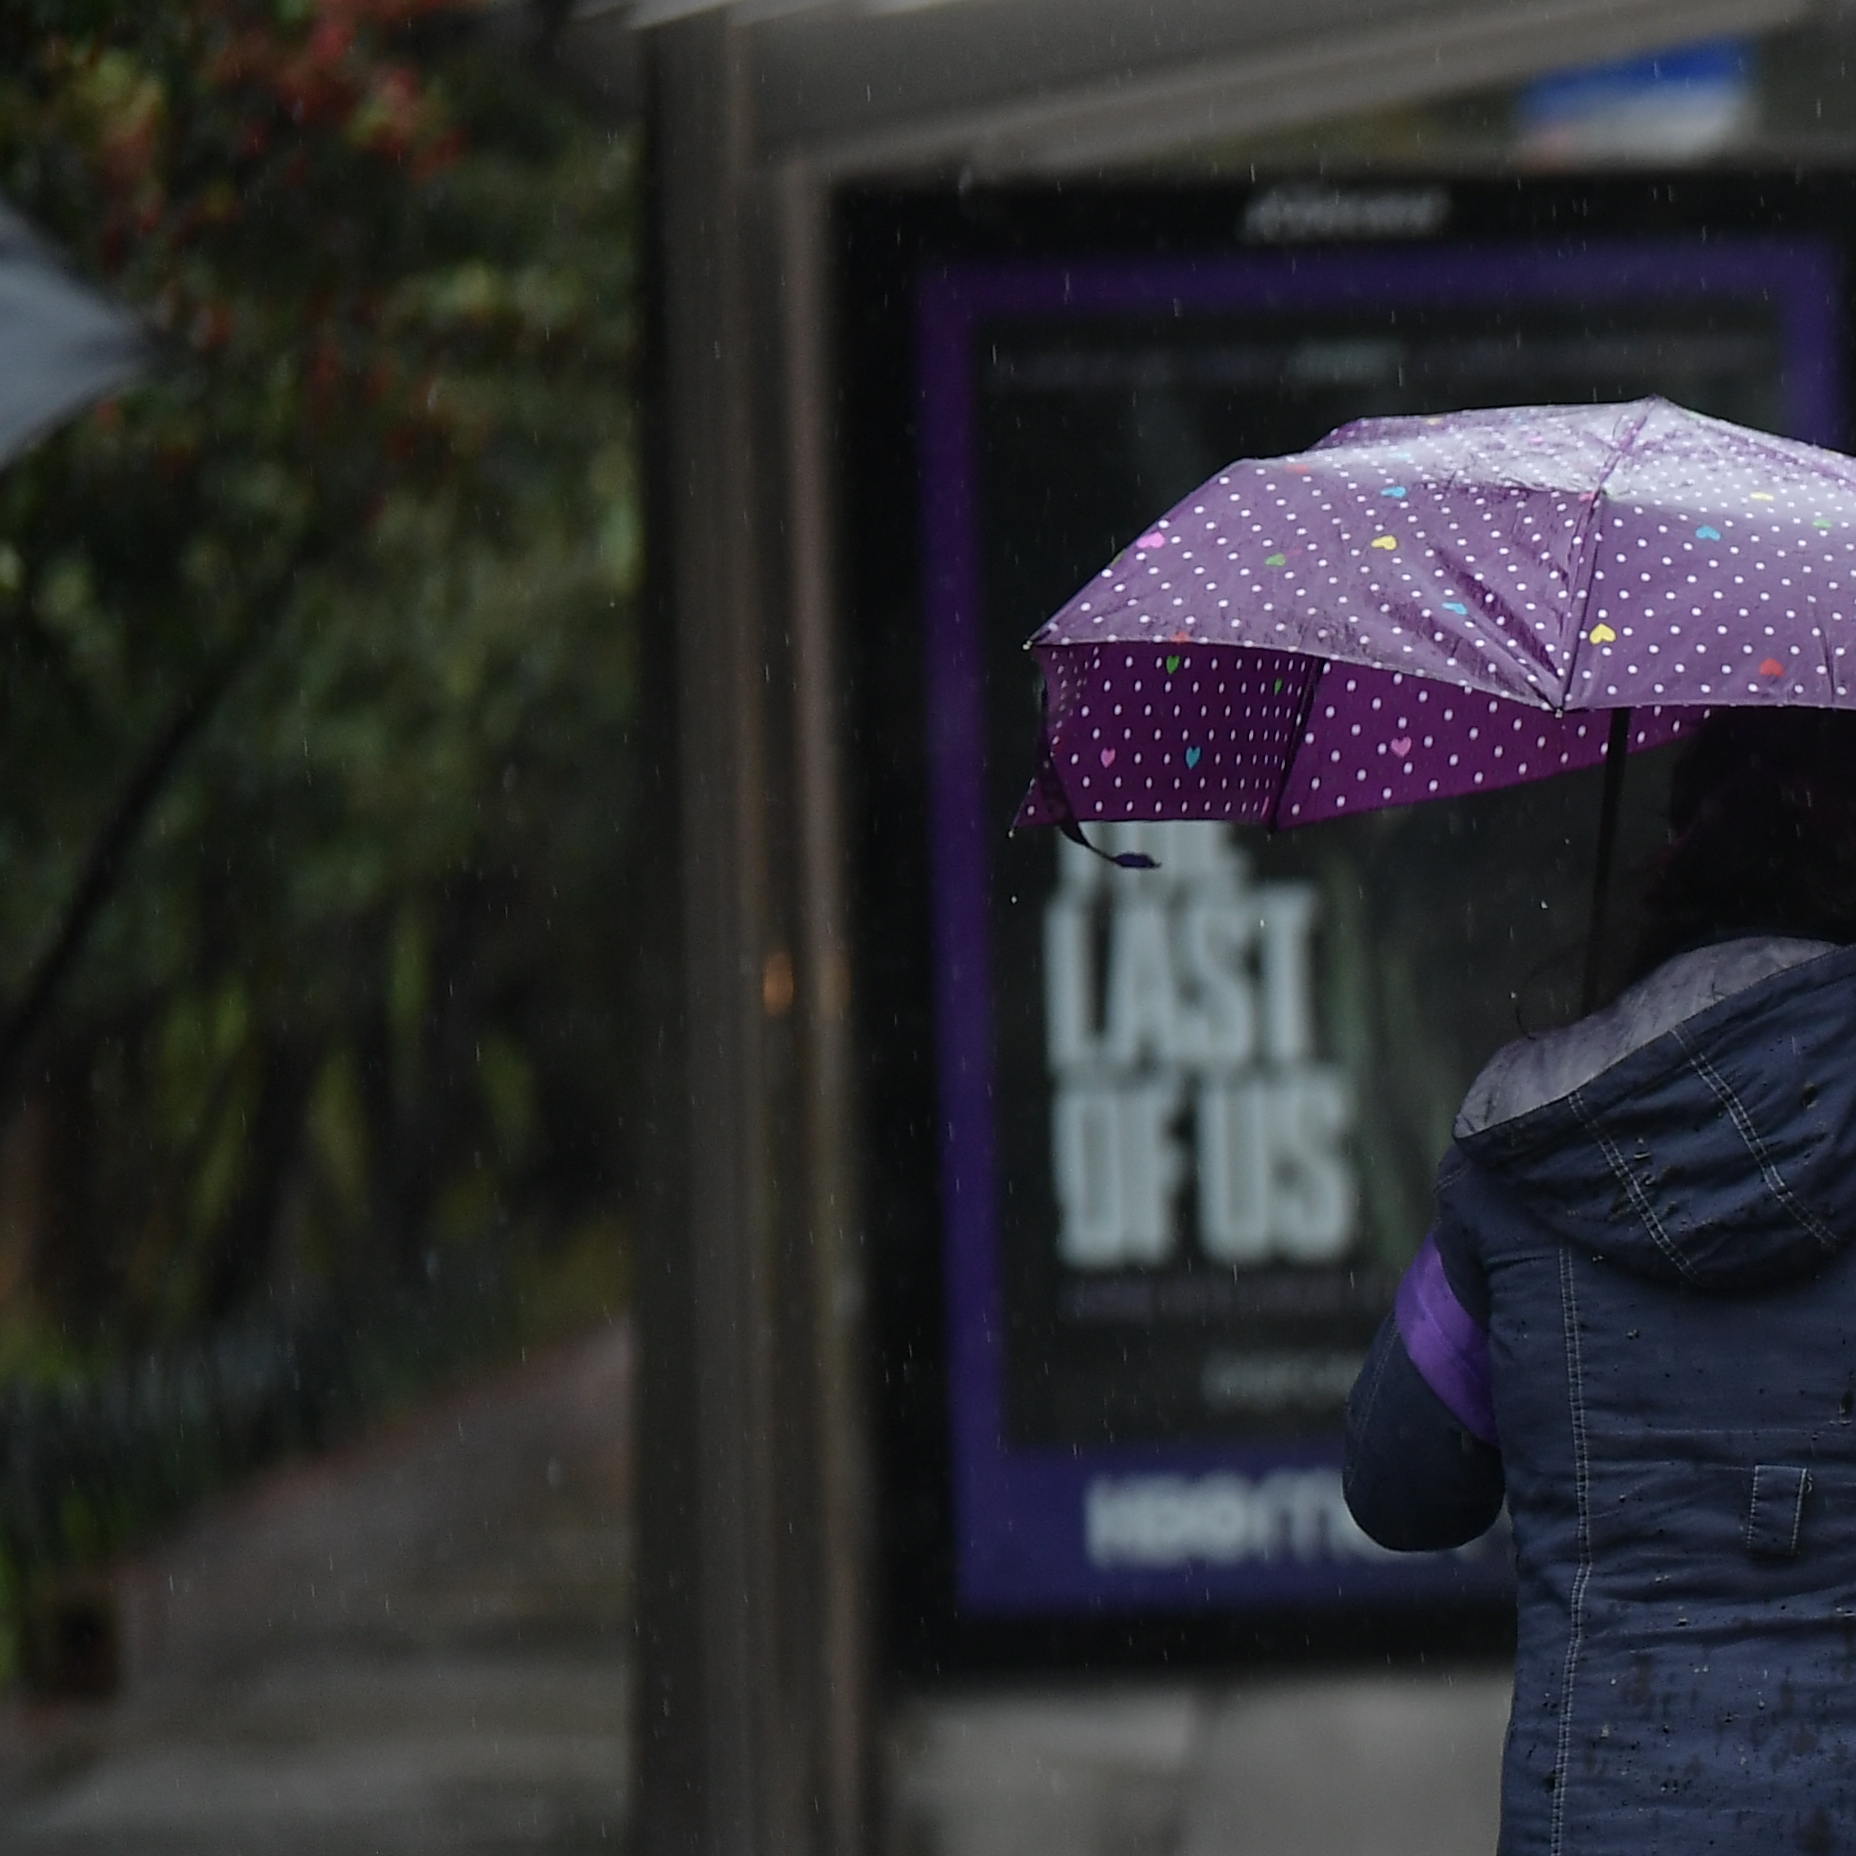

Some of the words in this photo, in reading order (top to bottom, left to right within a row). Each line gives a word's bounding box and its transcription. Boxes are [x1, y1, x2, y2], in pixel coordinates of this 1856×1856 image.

[1044, 882, 1318, 1066] LAST
[1052, 1070, 1184, 1266] OF
[1200, 1068, 1354, 1264] US
